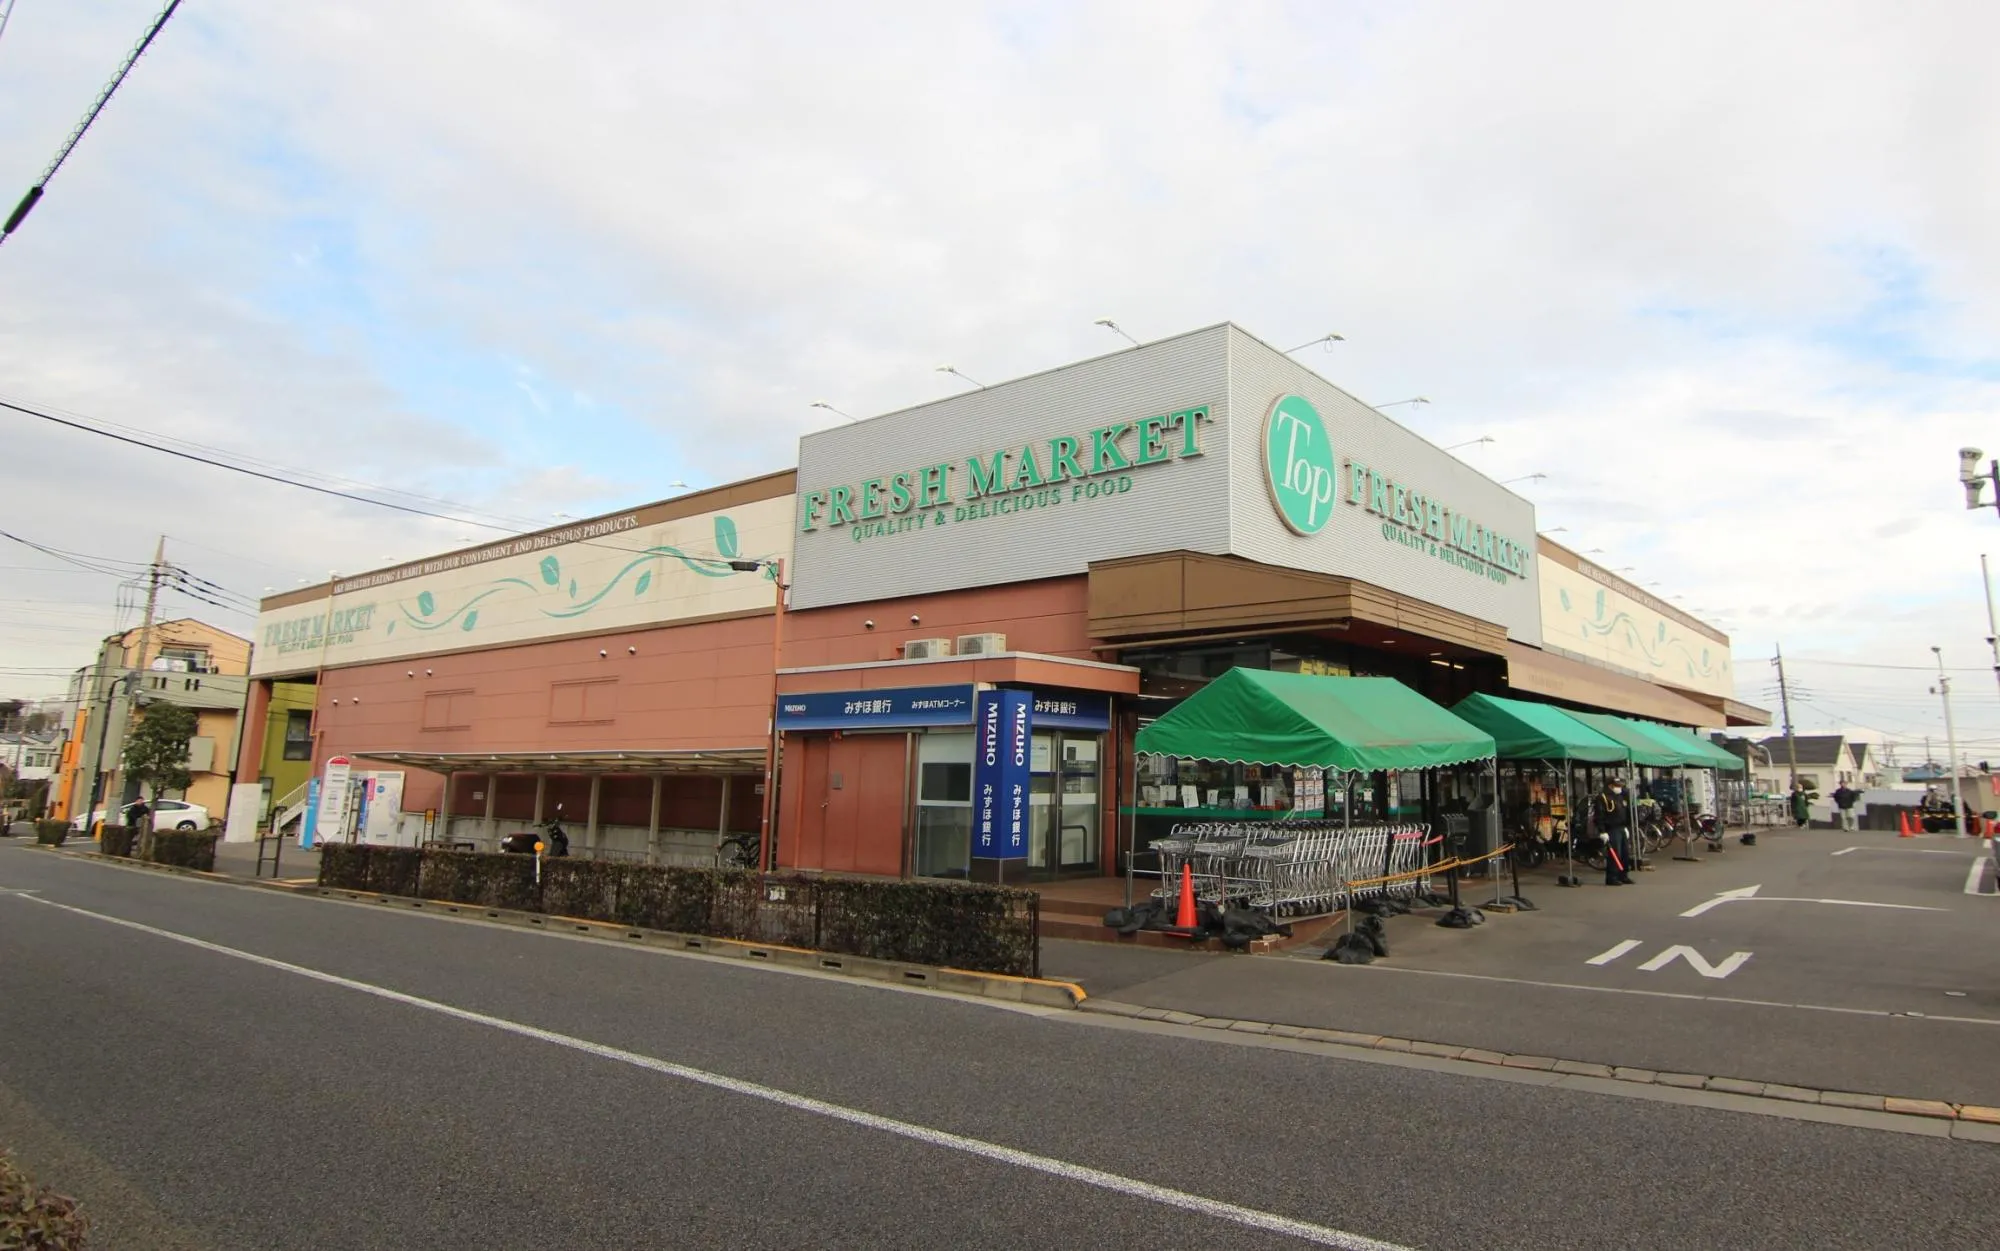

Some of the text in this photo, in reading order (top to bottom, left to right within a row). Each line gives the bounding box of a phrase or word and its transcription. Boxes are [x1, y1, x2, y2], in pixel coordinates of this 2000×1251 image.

[802, 404, 1212, 532] FRESH MARKET
[1277, 410, 1332, 526] Top
[852, 476, 1133, 543] QUALITY & DELICIOUS FOOD
[1346, 459, 1530, 578] FRESH MARKET
[424, 560, 443, 573] WITH
[444, 556, 461, 569] OUR
[461, 544, 513, 565] CONVENIENT
[513, 539, 532, 553] AND
[534, 527, 582, 549] DELICIOUS
[583, 514, 639, 538] PRODUCTS.
[1382, 523, 1507, 585] QUALITY & DELICIOUS FOOD
[844, 699, 892, 714] みずほ銀行
[986, 702, 998, 766] MIZUHO
[1015, 703, 1027, 767] MIZUHO
[1034, 699, 1077, 715] みずほ銀行
[982, 784, 993, 847] みずほ銀行
[1012, 784, 1022, 847] みずほ銀行
[1584, 938, 1754, 979] IN
